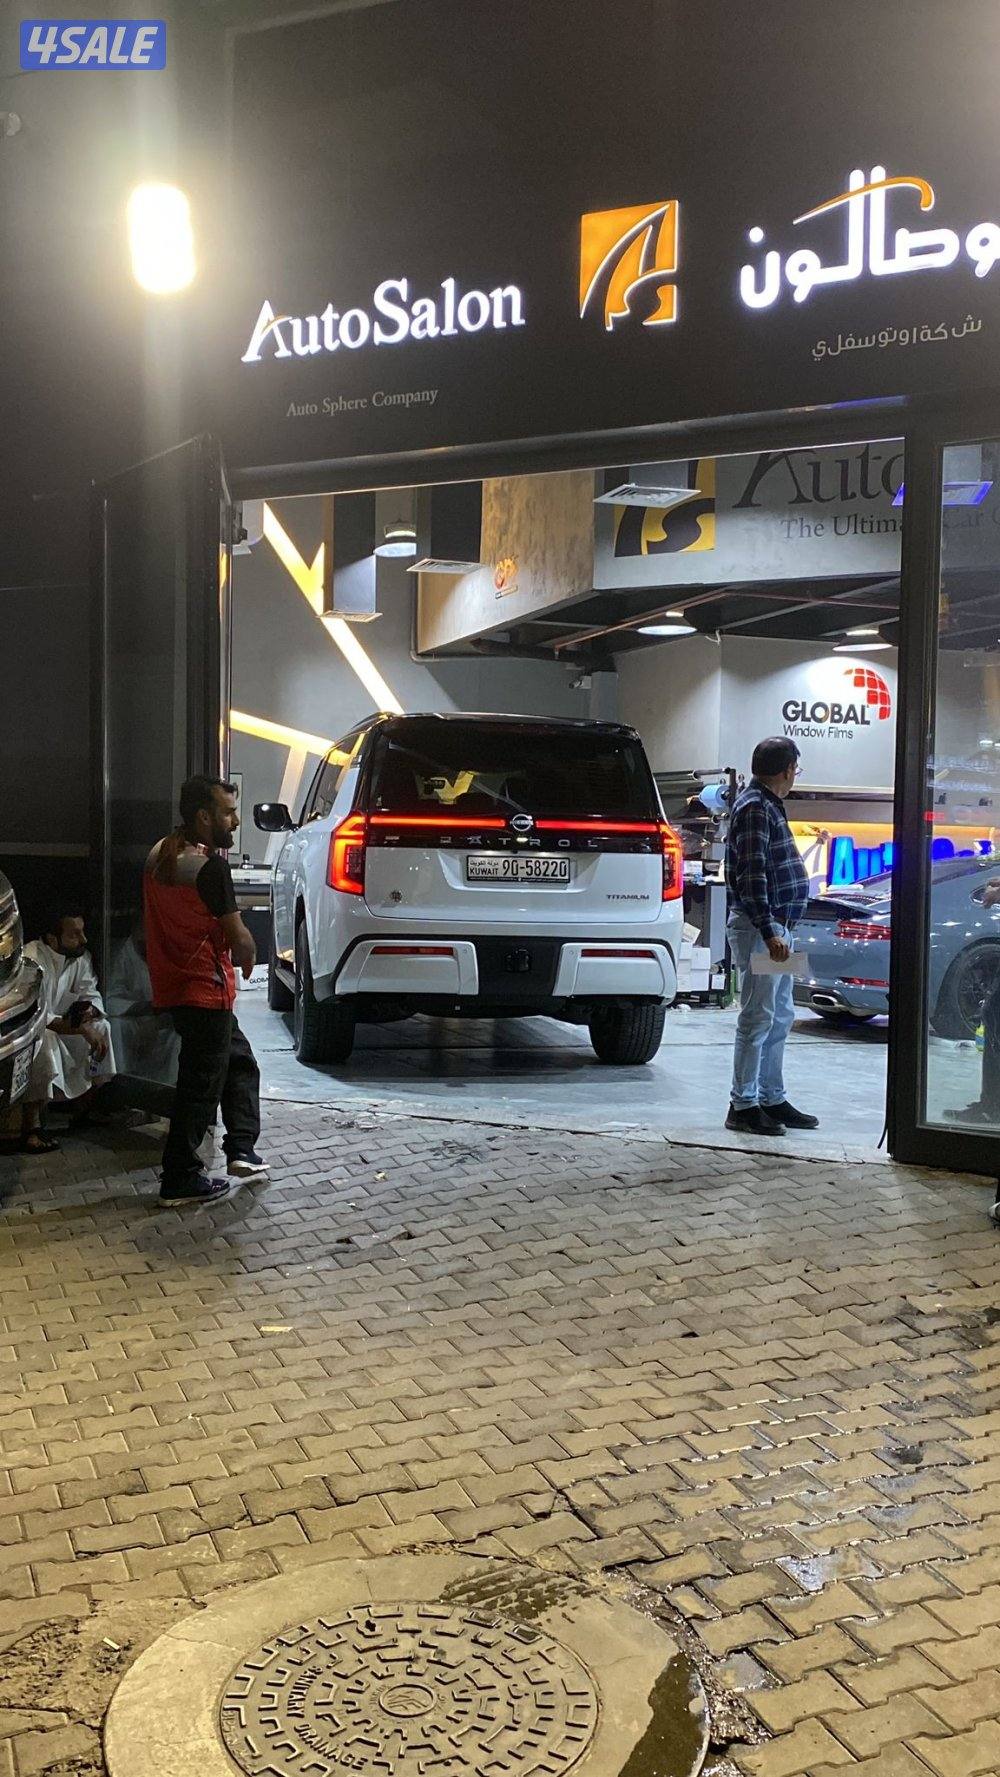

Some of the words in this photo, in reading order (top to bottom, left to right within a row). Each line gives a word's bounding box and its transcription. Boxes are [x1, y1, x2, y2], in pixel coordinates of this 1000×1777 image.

[241, 277, 526, 363] AutoSalon
[286, 402, 318, 417] Auto
[322, 396, 368, 416] Sphere
[372, 389, 439, 408] Company
[781, 517, 824, 539] The
[832, 512, 903, 536] Ultim
[782, 700, 870, 726] GLOBAL
[783, 724, 825, 738] Window
[827, 726, 854, 739] Films
[469, 867, 499, 876] KUWAIT
[502, 859, 567, 878] 90-58220
